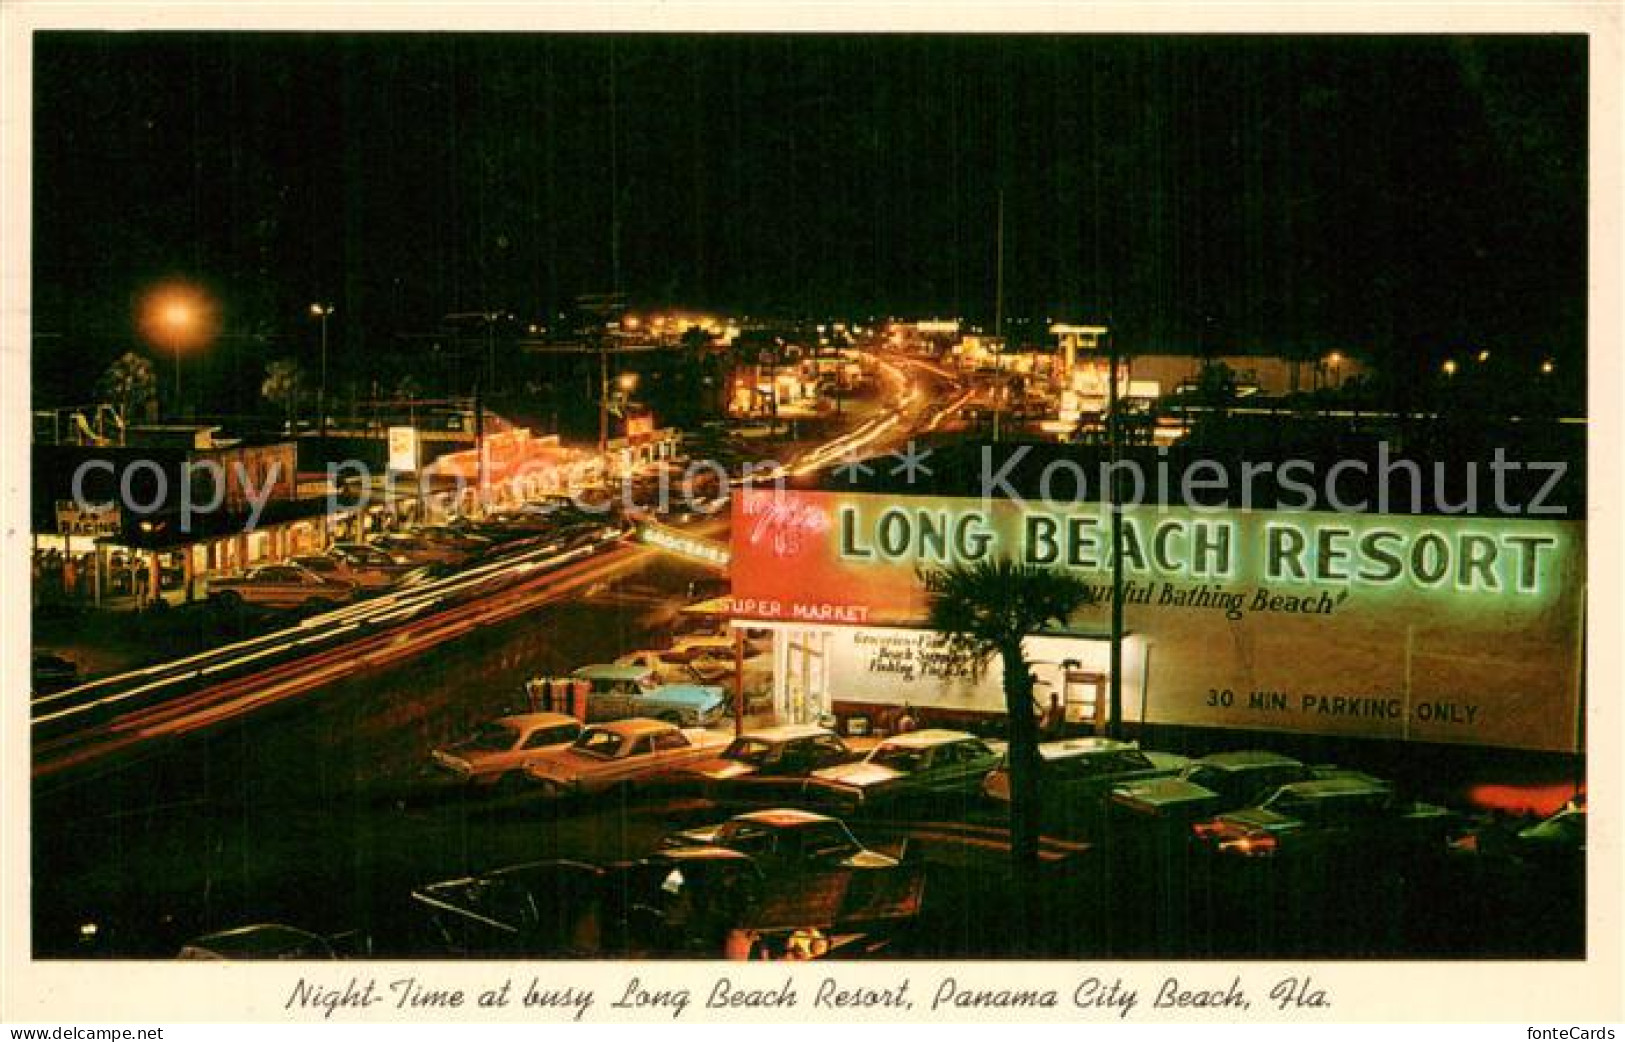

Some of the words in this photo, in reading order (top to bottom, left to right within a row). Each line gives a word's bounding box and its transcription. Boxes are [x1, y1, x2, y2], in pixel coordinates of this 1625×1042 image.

[840, 504, 996, 563] LONG
[1022, 512, 1235, 578] BEACH
[1265, 522, 1558, 593] RESORT
[719, 597, 781, 616] SUPER
[793, 602, 869, 622] MARKET
[1158, 582, 1246, 620] Bathing
[1206, 688, 1234, 708] 30
[1302, 693, 1401, 719] PARKING
[1416, 702, 1479, 725] ONLY
